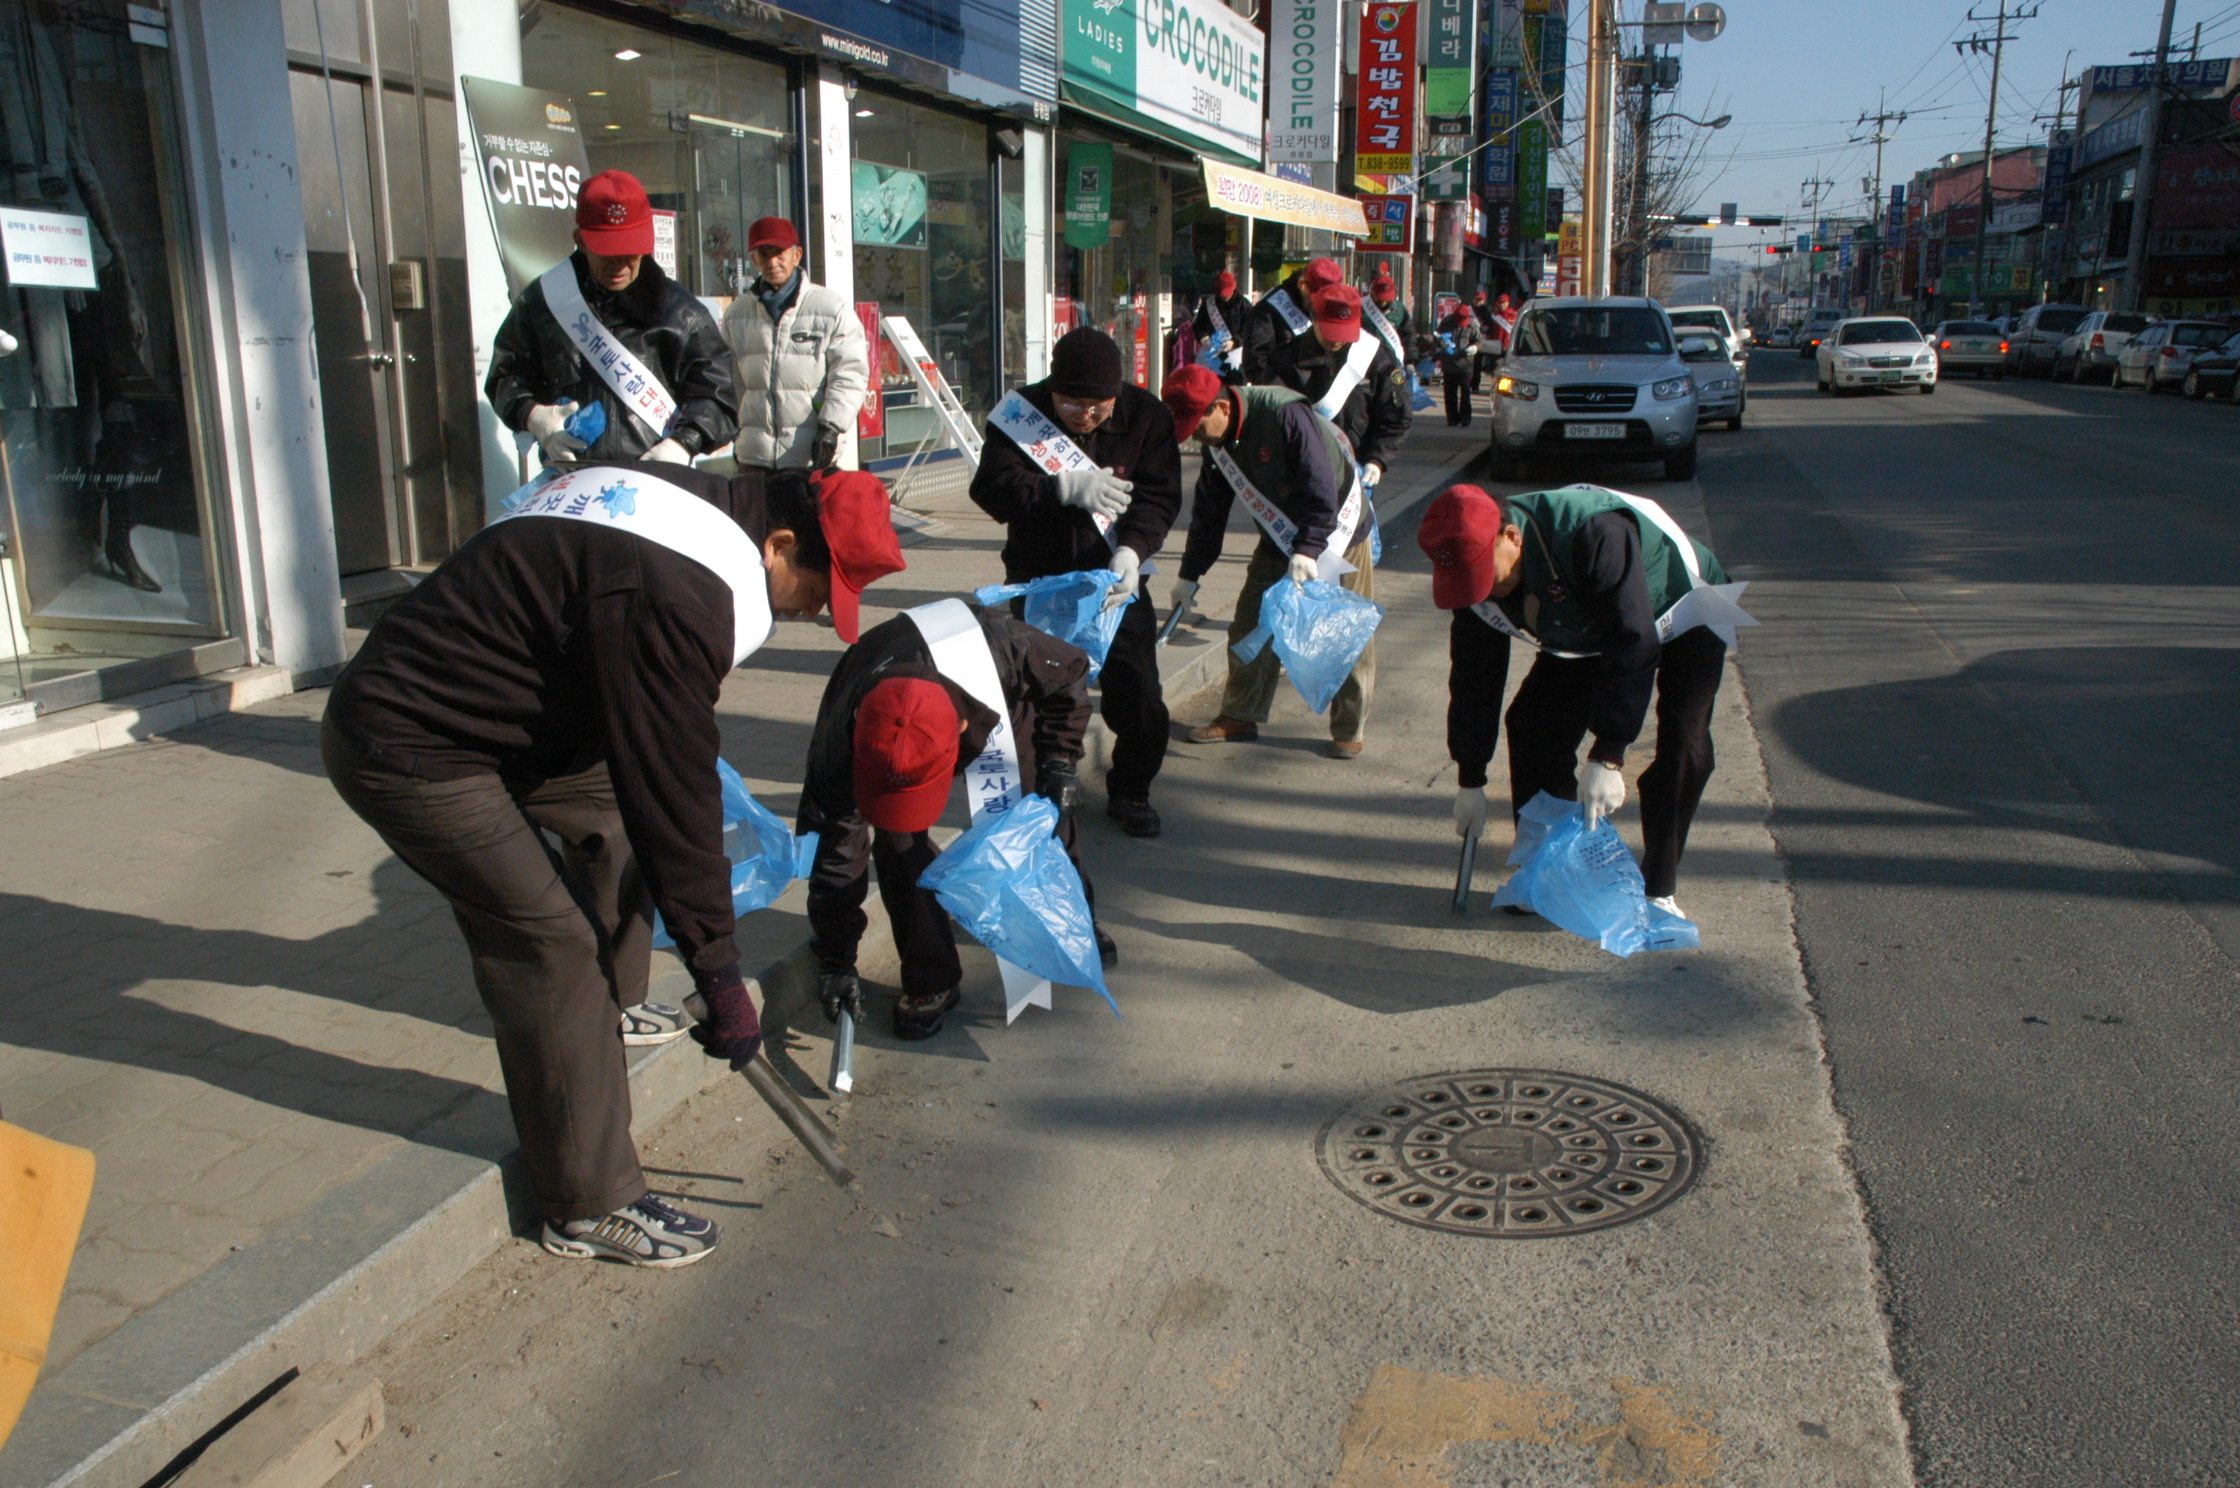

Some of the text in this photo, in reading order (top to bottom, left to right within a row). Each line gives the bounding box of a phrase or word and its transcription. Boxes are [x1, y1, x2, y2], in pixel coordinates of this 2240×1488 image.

[821, 33, 889, 67] www.minigold.co.kr
[1078, 15, 1123, 53] LADIES
[1144, 0, 1259, 104] CROCODILE
[1368, 38, 1404, 149] 김밥천국
[1272, 135, 1330, 149] 크로커다일
[1358, 156, 1410, 171] T.838-9599
[488, 156, 580, 210] CHESS
[1237, 182, 1262, 208] 2008!
[1499, 206, 1510, 250] SHOW
[1594, 426, 1620, 436] 3795
[978, 747, 1011, 814] 국토사랑
